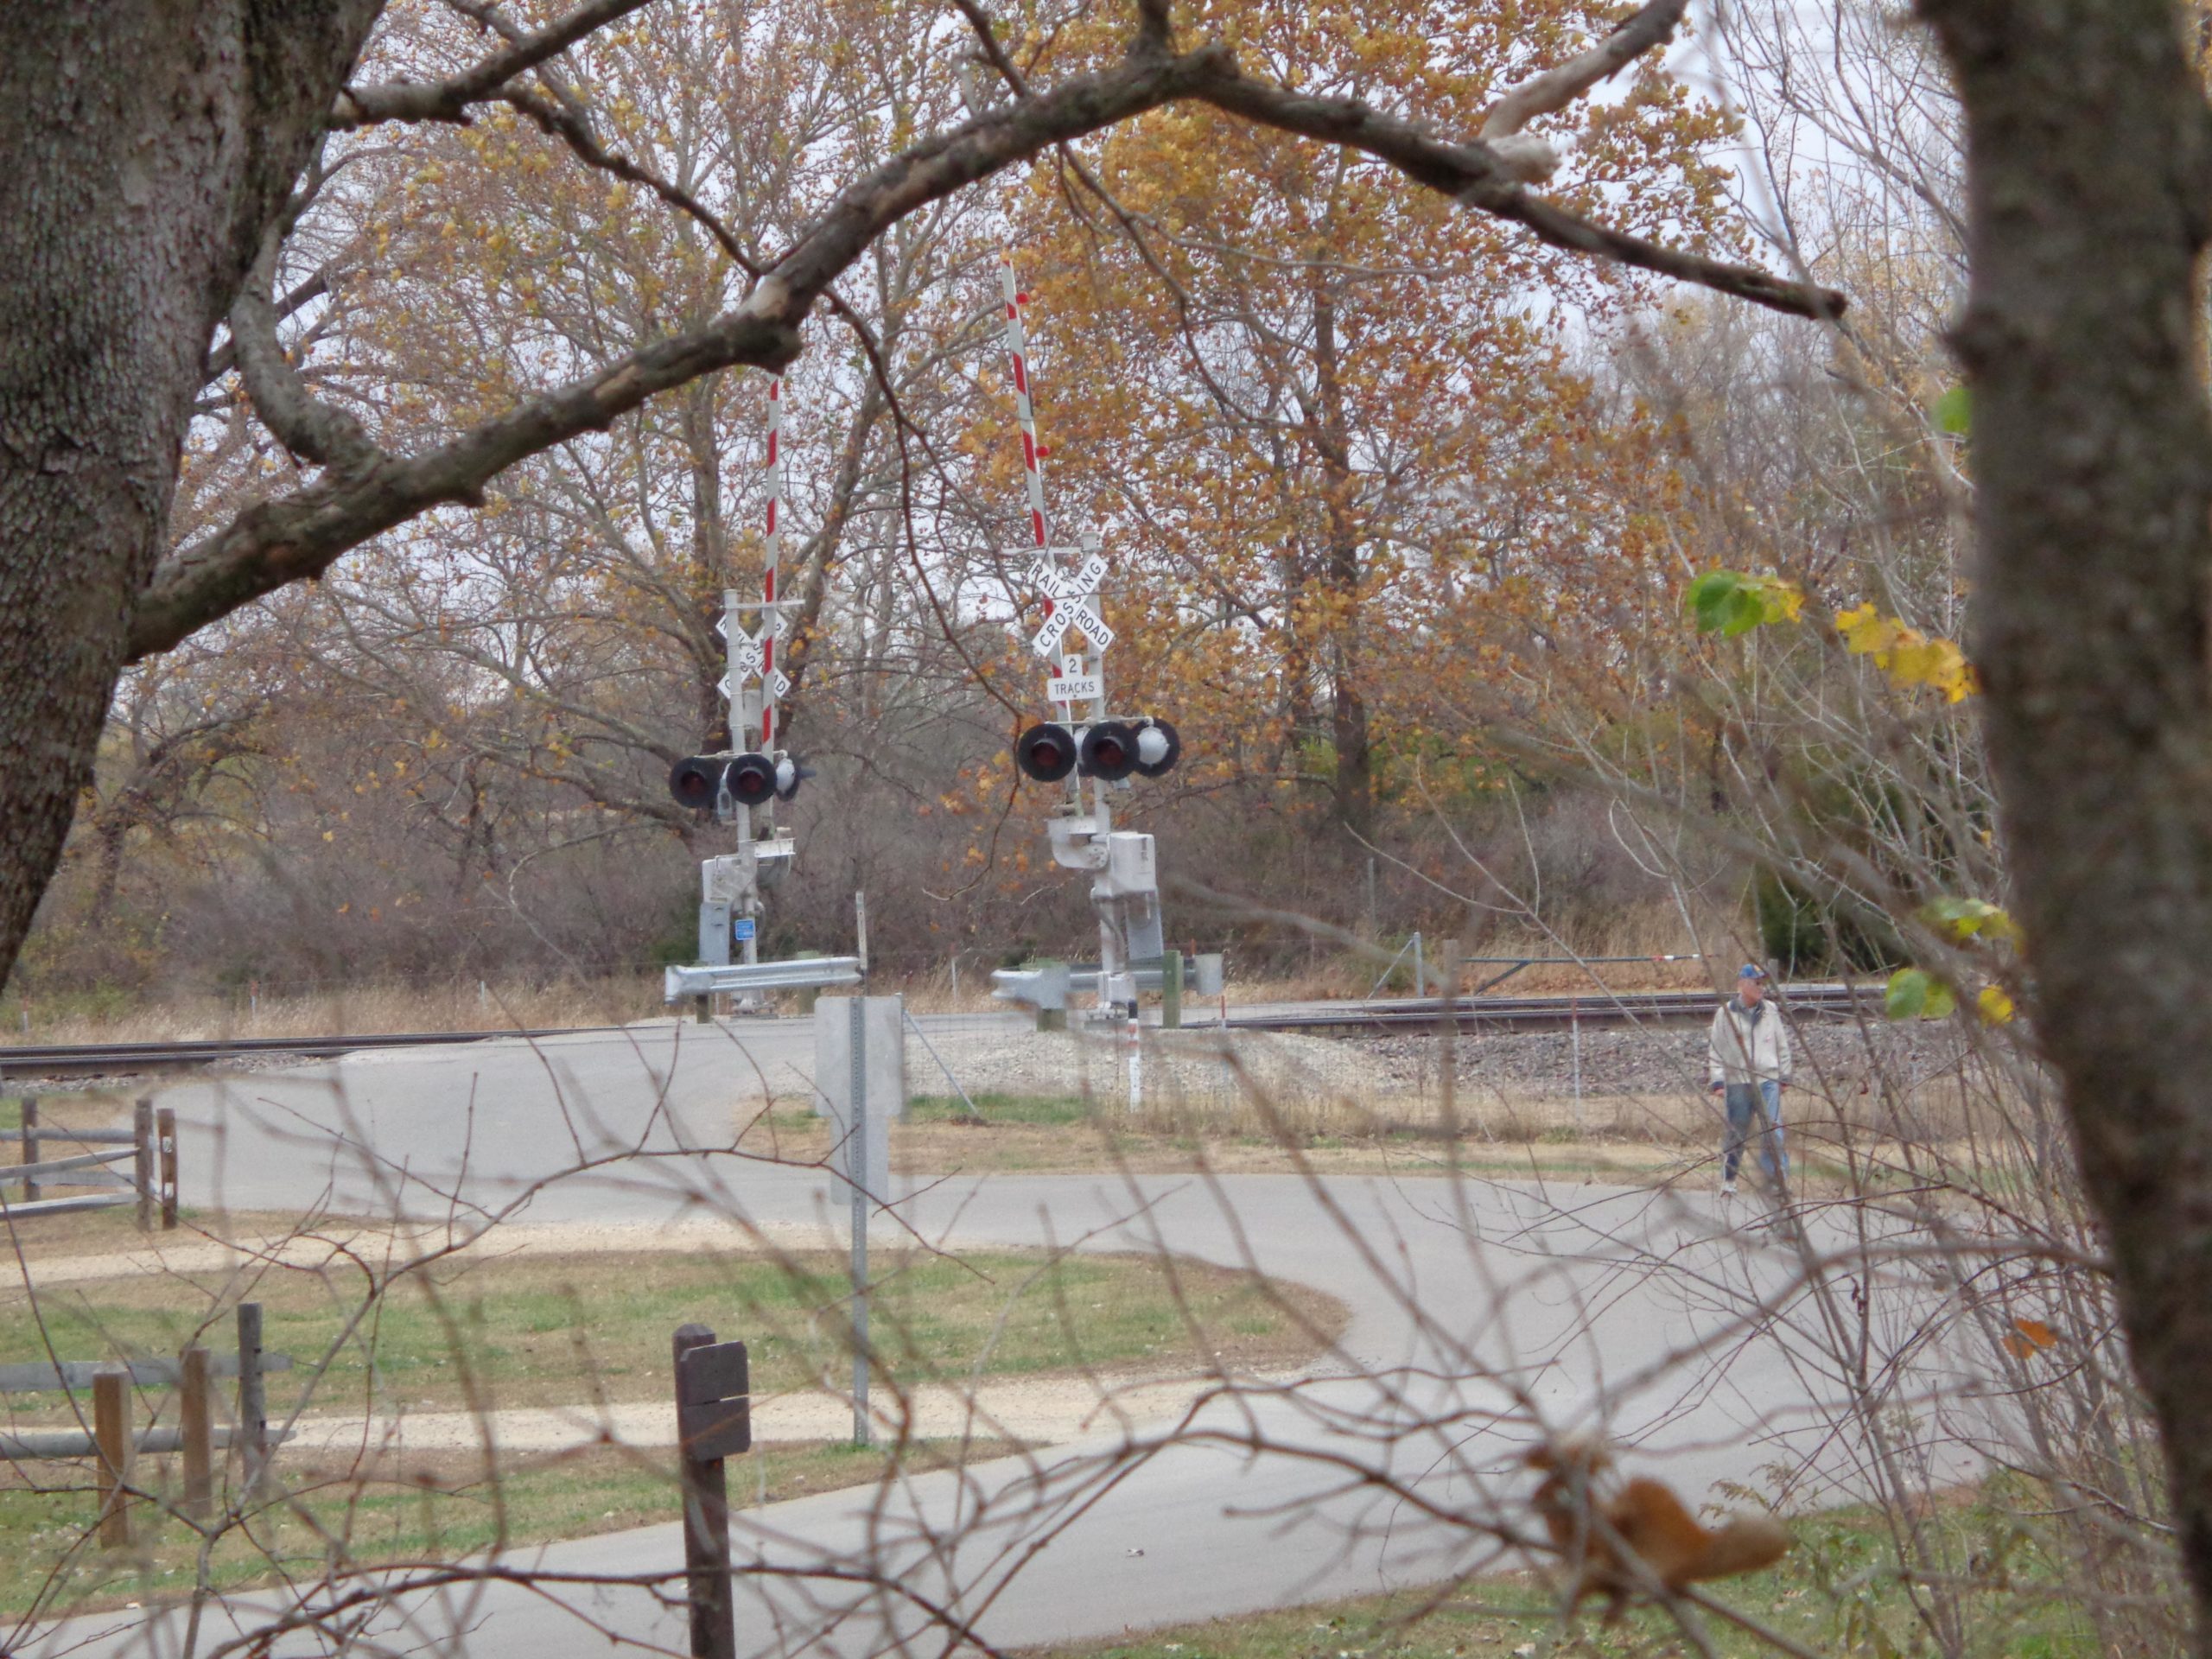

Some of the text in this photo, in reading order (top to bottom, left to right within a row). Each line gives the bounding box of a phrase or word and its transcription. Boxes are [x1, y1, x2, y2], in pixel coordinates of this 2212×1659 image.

[1031, 563, 1109, 645] RAIL ROAD
[1039, 563, 1102, 647] CROSSING
[1054, 681, 1095, 694] TRACKS
[1068, 658, 1078, 674] 2
